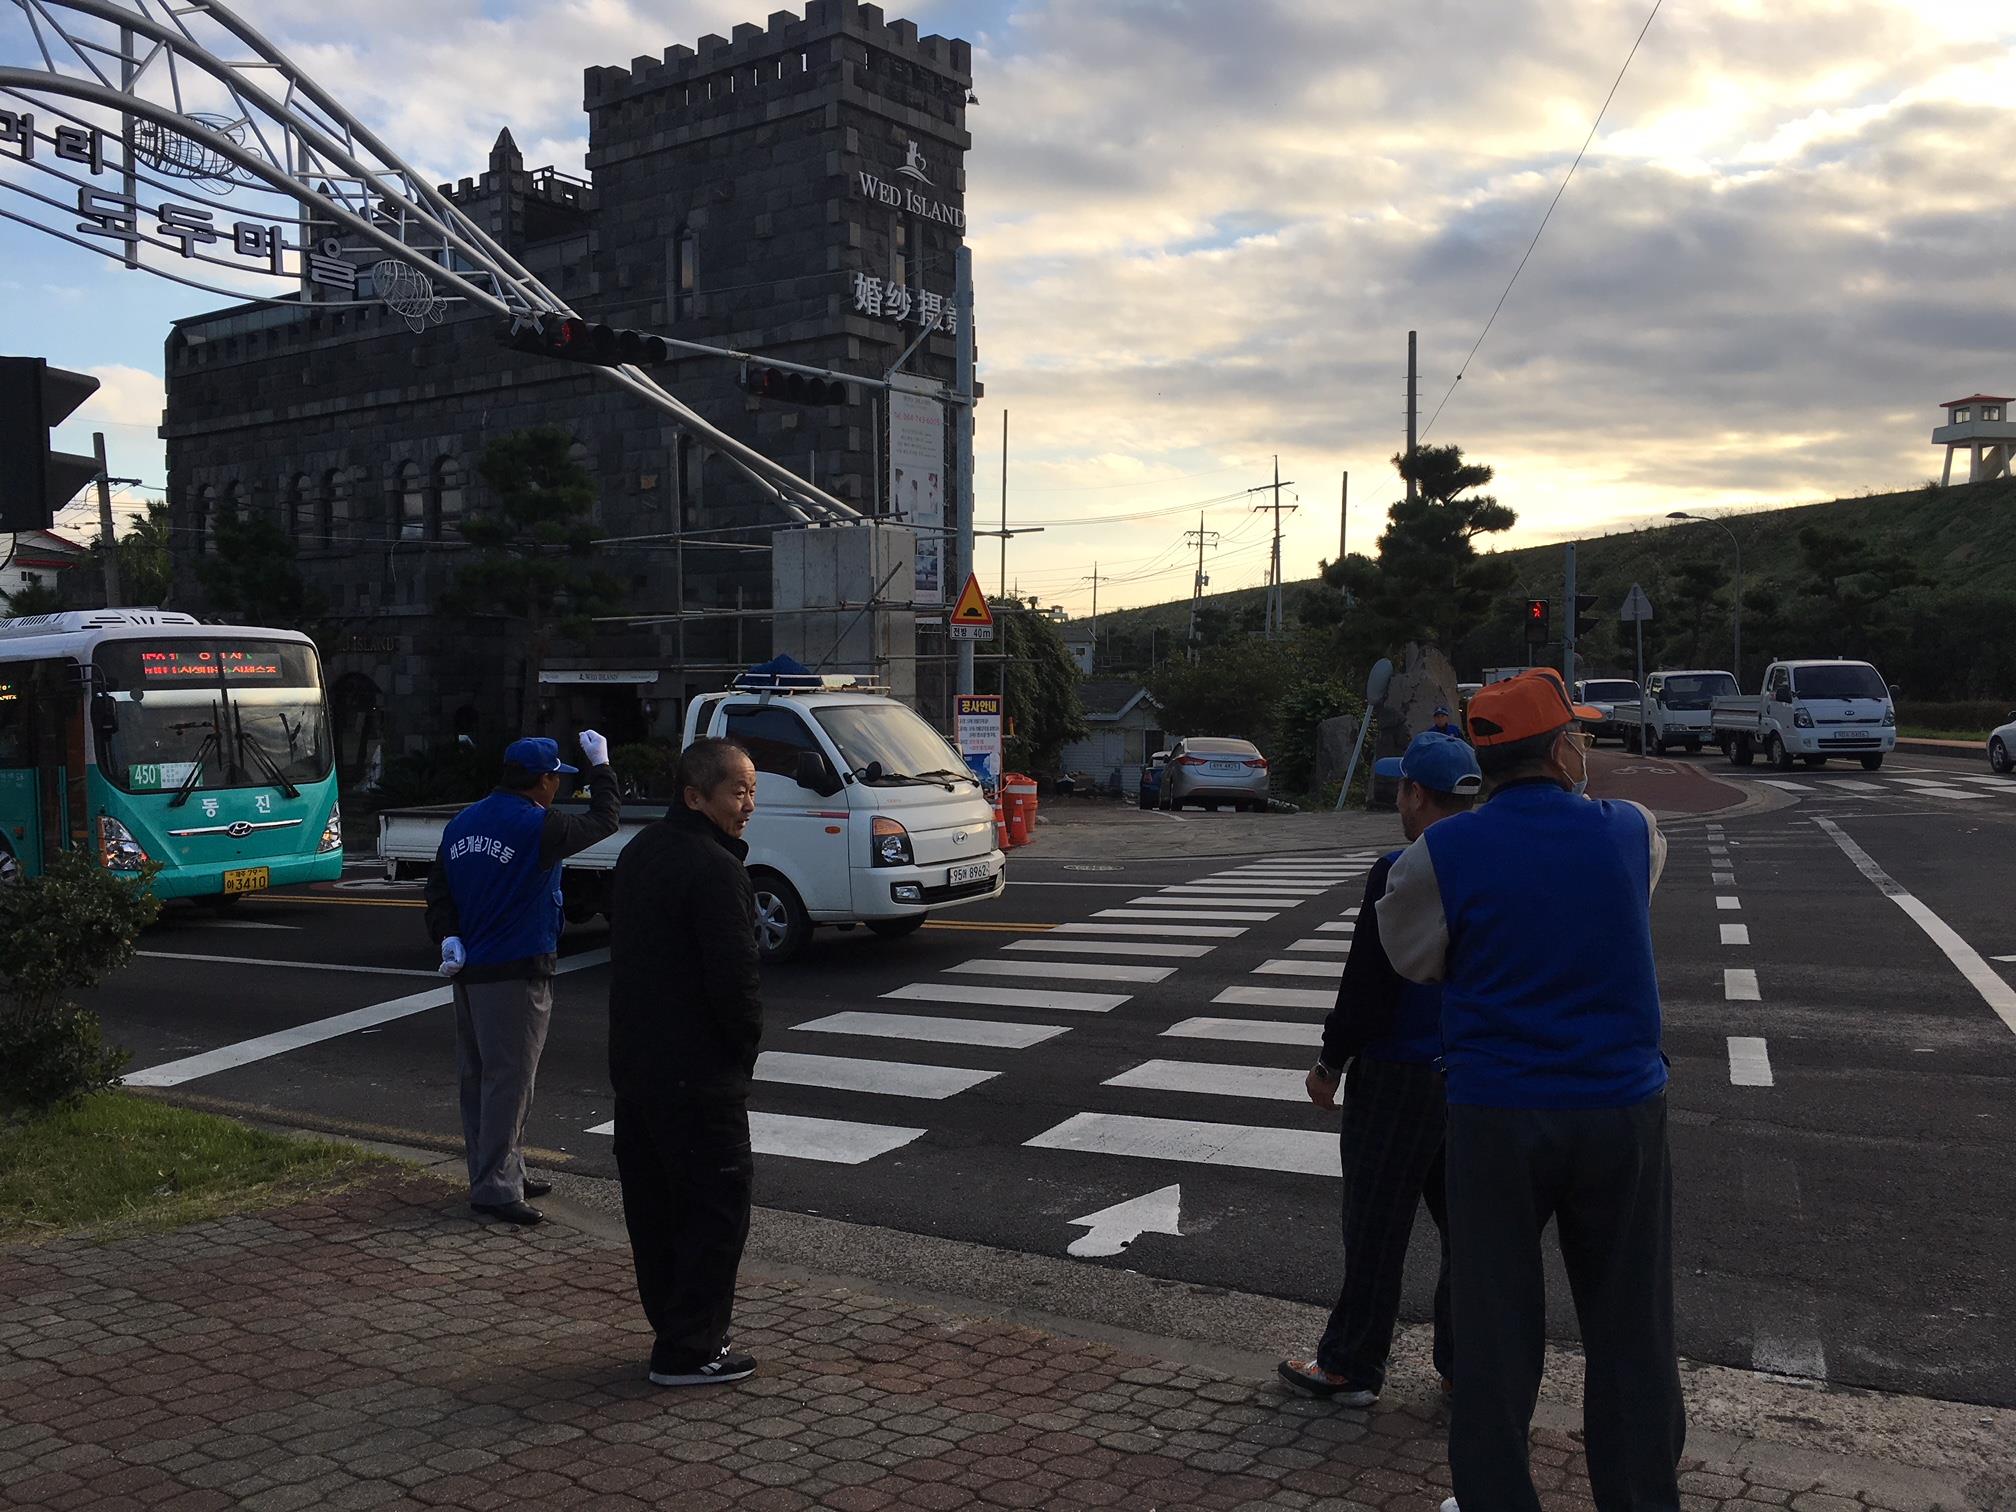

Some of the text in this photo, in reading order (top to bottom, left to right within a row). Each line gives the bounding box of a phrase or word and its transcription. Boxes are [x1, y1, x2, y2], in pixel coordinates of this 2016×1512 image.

[858, 170, 966, 229] WED ISLAND
[76, 185, 358, 291] 도두마을
[953, 627, 991, 638] 전방 40m
[961, 700, 997, 713] 공사안내
[134, 764, 156, 785] 450
[449, 835, 515, 864] 바르게살기운동
[969, 864, 987, 879] 8962
